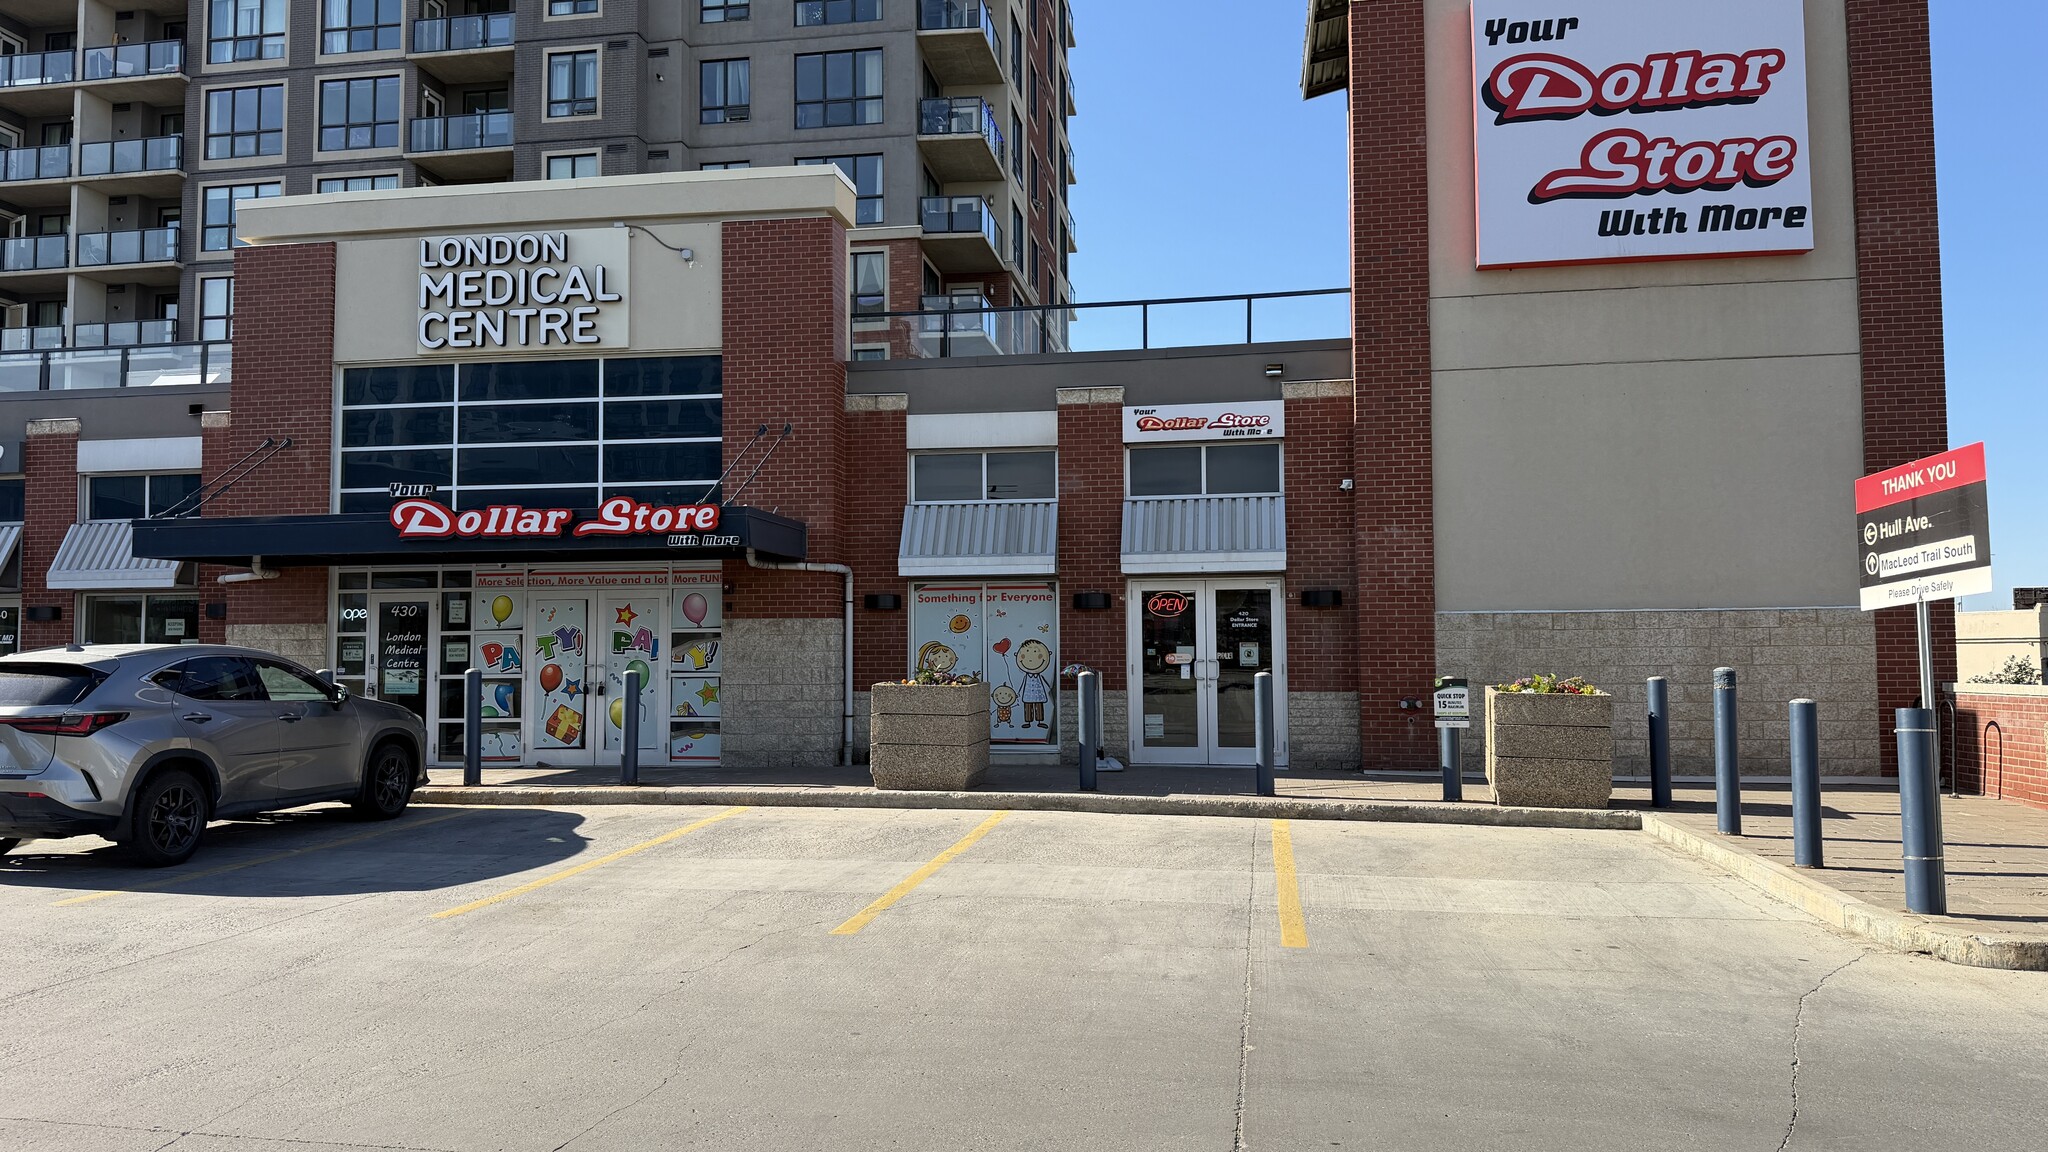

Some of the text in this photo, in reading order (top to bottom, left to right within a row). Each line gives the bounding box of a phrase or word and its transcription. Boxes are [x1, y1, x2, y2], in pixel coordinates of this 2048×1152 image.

[1484, 17, 1579, 46] Your
[1484, 49, 1786, 122] Dollar
[1530, 128, 1798, 202] Store
[1597, 205, 1807, 237] With More
[419, 232, 568, 268] LONDON
[419, 264, 622, 309] MEDICAL
[418, 306, 600, 349] CENTRE
[1137, 413, 1270, 432] Dollar Store
[1882, 460, 1957, 495] THANK YOU
[390, 483, 433, 497] Your
[390, 496, 720, 537] Dollar Store
[1879, 515, 1933, 540] Hull Ave.
[667, 535, 740, 546] With More
[1881, 543, 1973, 571] MacLeod Trail South
[558, 576, 584, 585] More
[587, 575, 618, 585] Value
[620, 575, 641, 585] and
[654, 575, 667, 584] lot
[674, 575, 697, 583] More
[1888, 579, 1955, 599] Please Drive Safely
[918, 593, 976, 604] Something
[1001, 592, 1053, 603] Everyone
[1150, 598, 1185, 611] OPEN
[0, 610, 8, 619] 0
[343, 608, 368, 621] ope
[391, 605, 418, 617] 430
[386, 631, 421, 642] London
[384, 645, 422, 655] Medical
[386, 658, 420, 668] Centre
[1438, 700, 1447, 709] 15
